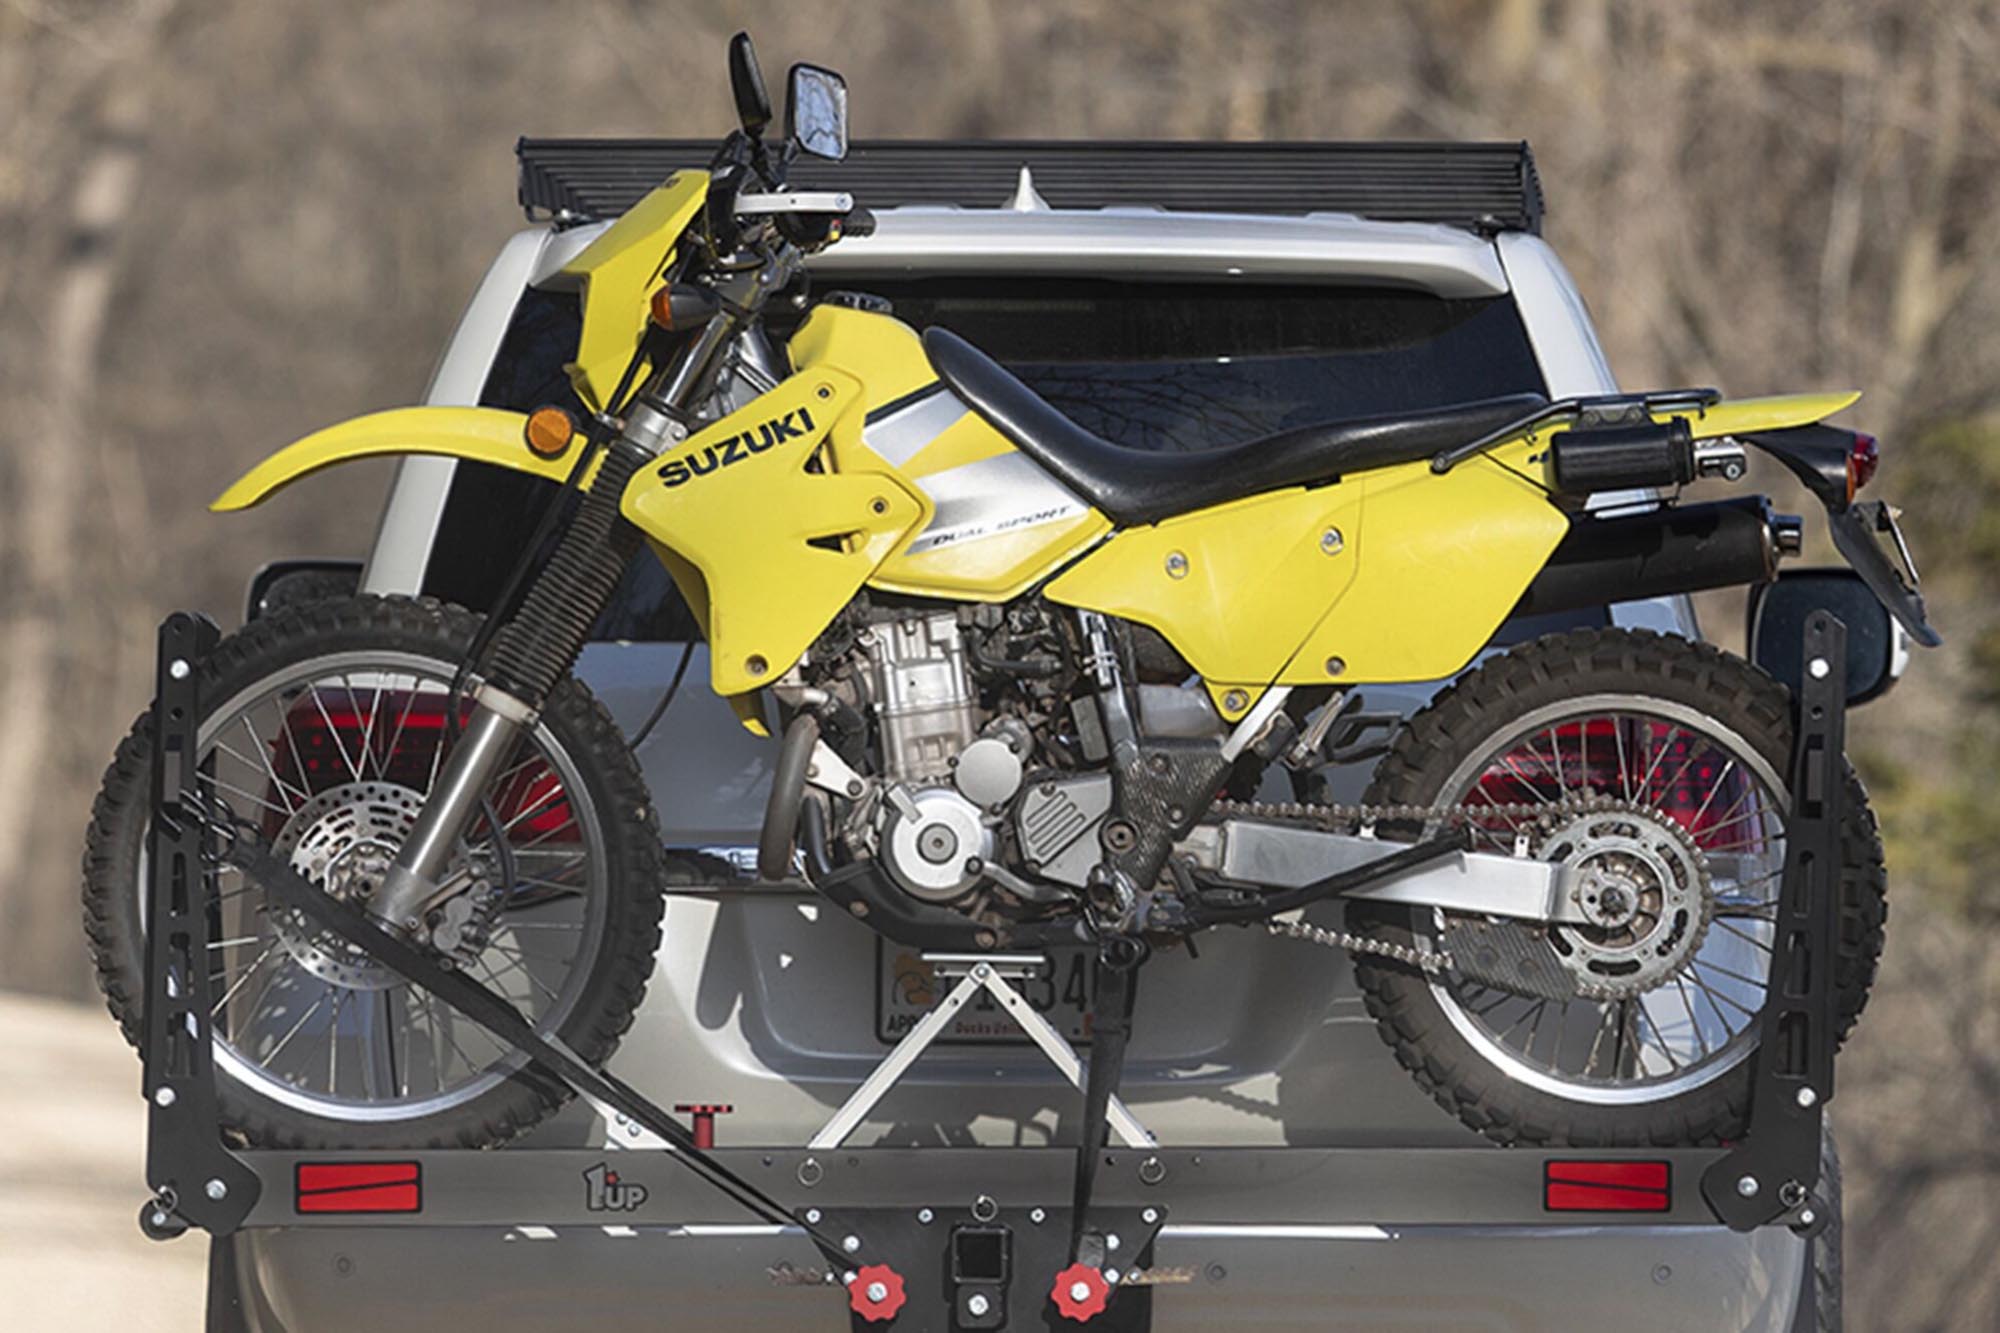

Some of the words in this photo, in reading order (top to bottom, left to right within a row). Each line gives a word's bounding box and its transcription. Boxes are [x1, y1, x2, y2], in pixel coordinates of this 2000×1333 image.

[657, 407, 816, 488] SUZUKI
[932, 527, 985, 546] DUAL
[996, 505, 1071, 531] SPORT
